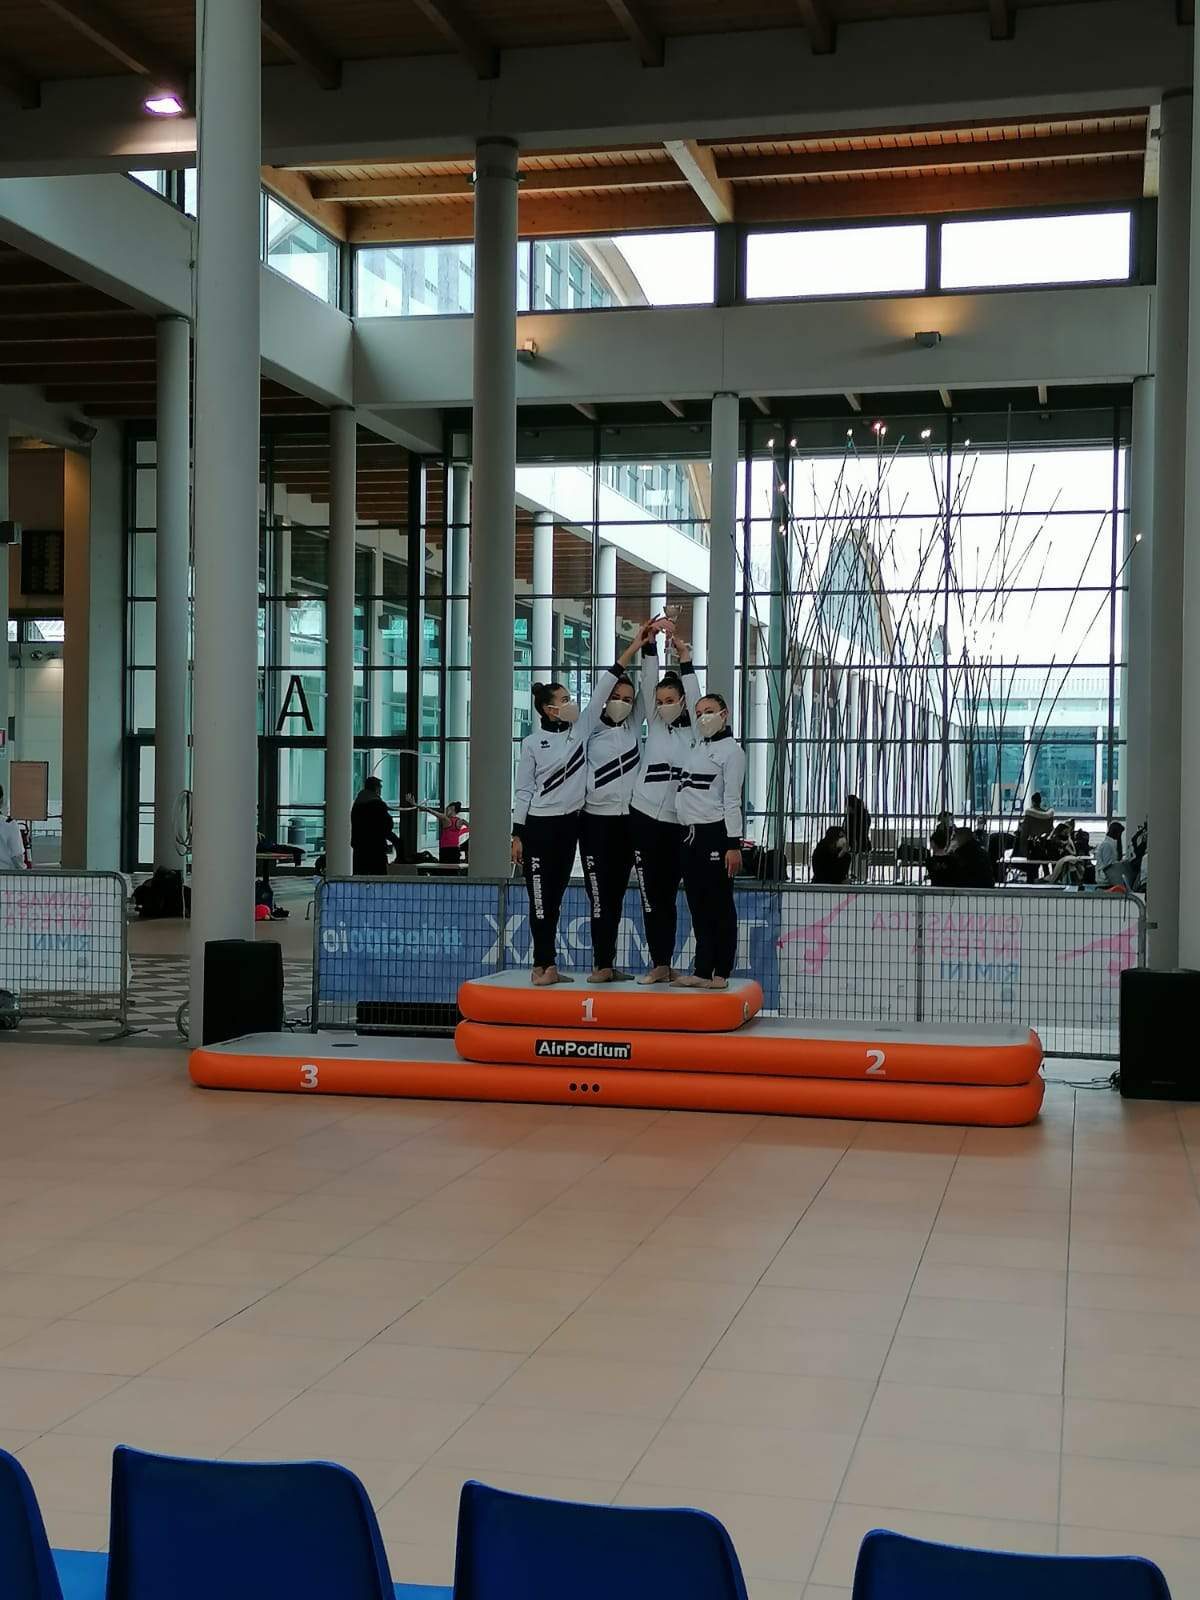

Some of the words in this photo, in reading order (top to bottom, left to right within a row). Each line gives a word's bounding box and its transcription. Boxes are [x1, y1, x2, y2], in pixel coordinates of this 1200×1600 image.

[277, 675, 314, 731] A
[581, 997, 598, 1022] 1
[538, 1040, 629, 1059] AirPodium
[864, 1049, 887, 1075] 2
[300, 1064, 319, 1089] 3
